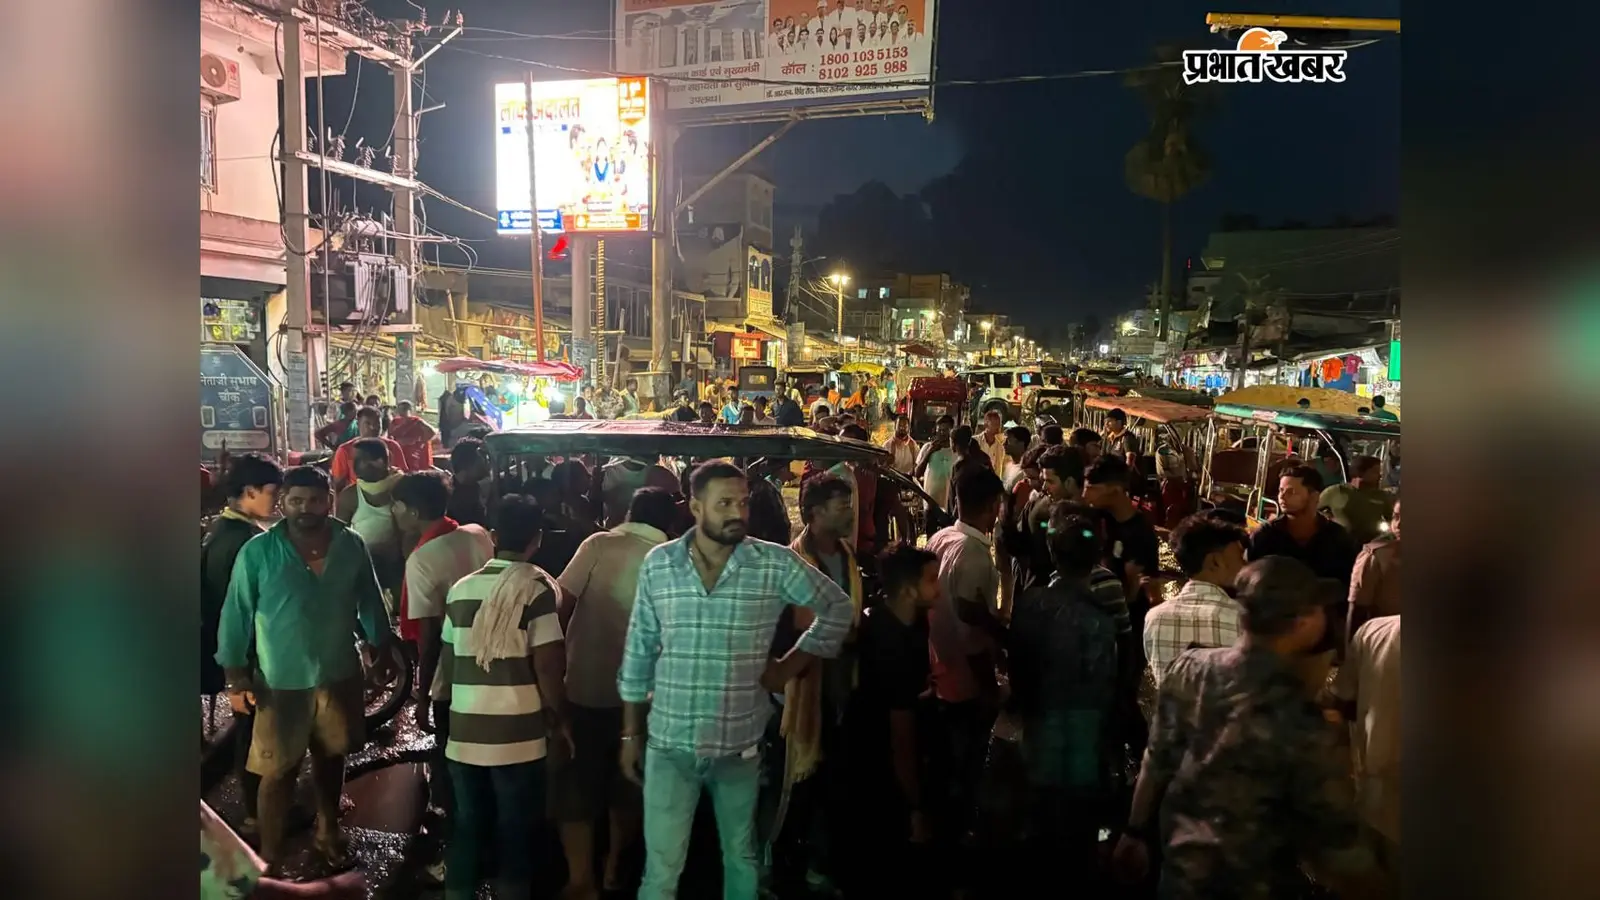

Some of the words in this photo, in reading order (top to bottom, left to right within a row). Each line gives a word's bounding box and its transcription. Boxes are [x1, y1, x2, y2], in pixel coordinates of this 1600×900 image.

[820, 52, 849, 65] 1800
[852, 49, 874, 63] 103
[877, 45, 909, 60] 5153
[723, 62, 760, 77] मुख्यमंत्री
[781, 61, 807, 76] कॉल
[818, 66, 849, 81] 8102
[855, 64, 878, 77] 925
[883, 60, 908, 74] 988
[200, 373, 227, 386] नेताजी
[229, 376, 257, 390] सुभाष
[218, 389, 240, 402] चौक
